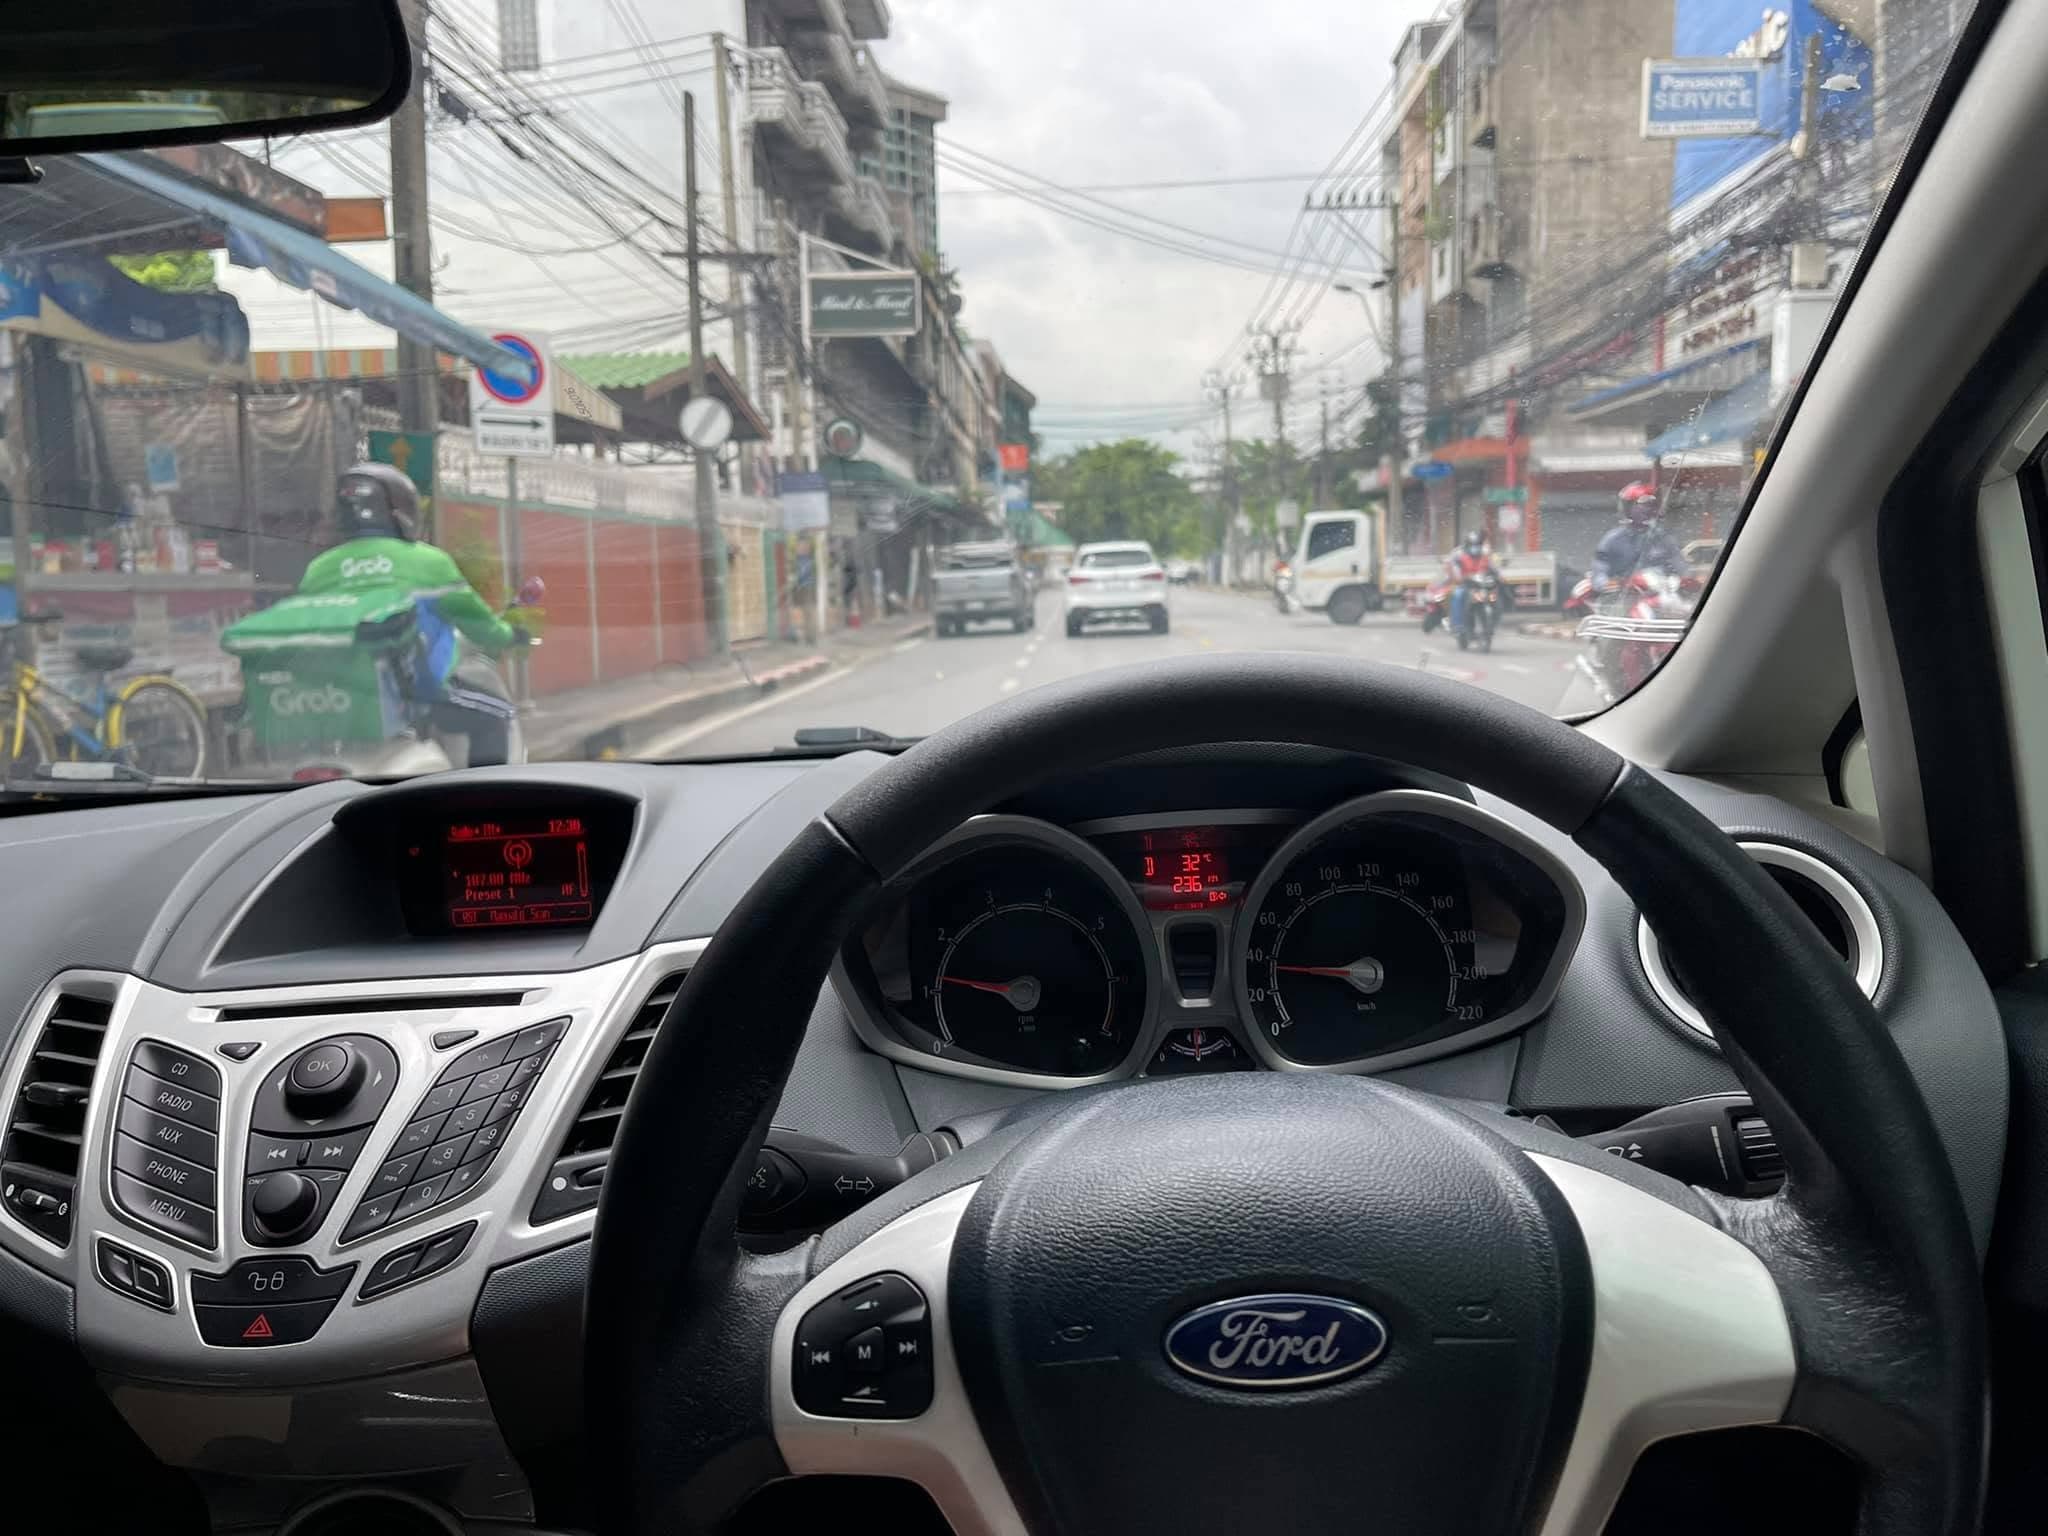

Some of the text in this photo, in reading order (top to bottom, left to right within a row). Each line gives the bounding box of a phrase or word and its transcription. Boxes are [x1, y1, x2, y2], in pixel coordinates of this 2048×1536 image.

[1654, 90, 1754, 111] SERVICE
[341, 555, 393, 578] Grab
[269, 683, 351, 717] Grab
[1182, 854, 1200, 872] 32
[1358, 863, 1380, 877] 120
[1319, 866, 1341, 881] 100
[1396, 872, 1419, 887] 140
[1173, 875, 1203, 893] 236
[1286, 883, 1302, 897] 80
[465, 887, 516, 901] Preset 1
[1045, 887, 1052, 900] 4
[1431, 895, 1454, 910] 160
[1098, 916, 1105, 930] 5
[1259, 912, 1276, 926] 60
[938, 927, 946, 941] 2
[1453, 930, 1476, 944] 180
[1247, 948, 1263, 962] 40
[1462, 966, 1488, 980] 200
[1249, 988, 1265, 1003] 20
[1458, 1005, 1484, 1021] 220
[1271, 1022, 1280, 1036] 0
[932, 1040, 941, 1055] 0
[171, 1062, 188, 1077] CD
[307, 1060, 331, 1073] OK
[531, 1057, 541, 1069] 3
[489, 1073, 500, 1084] 2
[157, 1091, 193, 1112] RADIO
[510, 1090, 520, 1103] 6
[465, 1109, 477, 1121] 5
[157, 1126, 183, 1144] AUX
[420, 1124, 430, 1136] 4
[487, 1128, 498, 1141] 9
[443, 1147, 454, 1160] 8
[146, 1160, 189, 1185] PHONE
[399, 1162, 408, 1174] 7
[422, 1185, 432, 1199] 0
[149, 1199, 187, 1221] MENU
[1208, 1310, 1341, 1369] Ford
[858, 1345, 871, 1360] M
